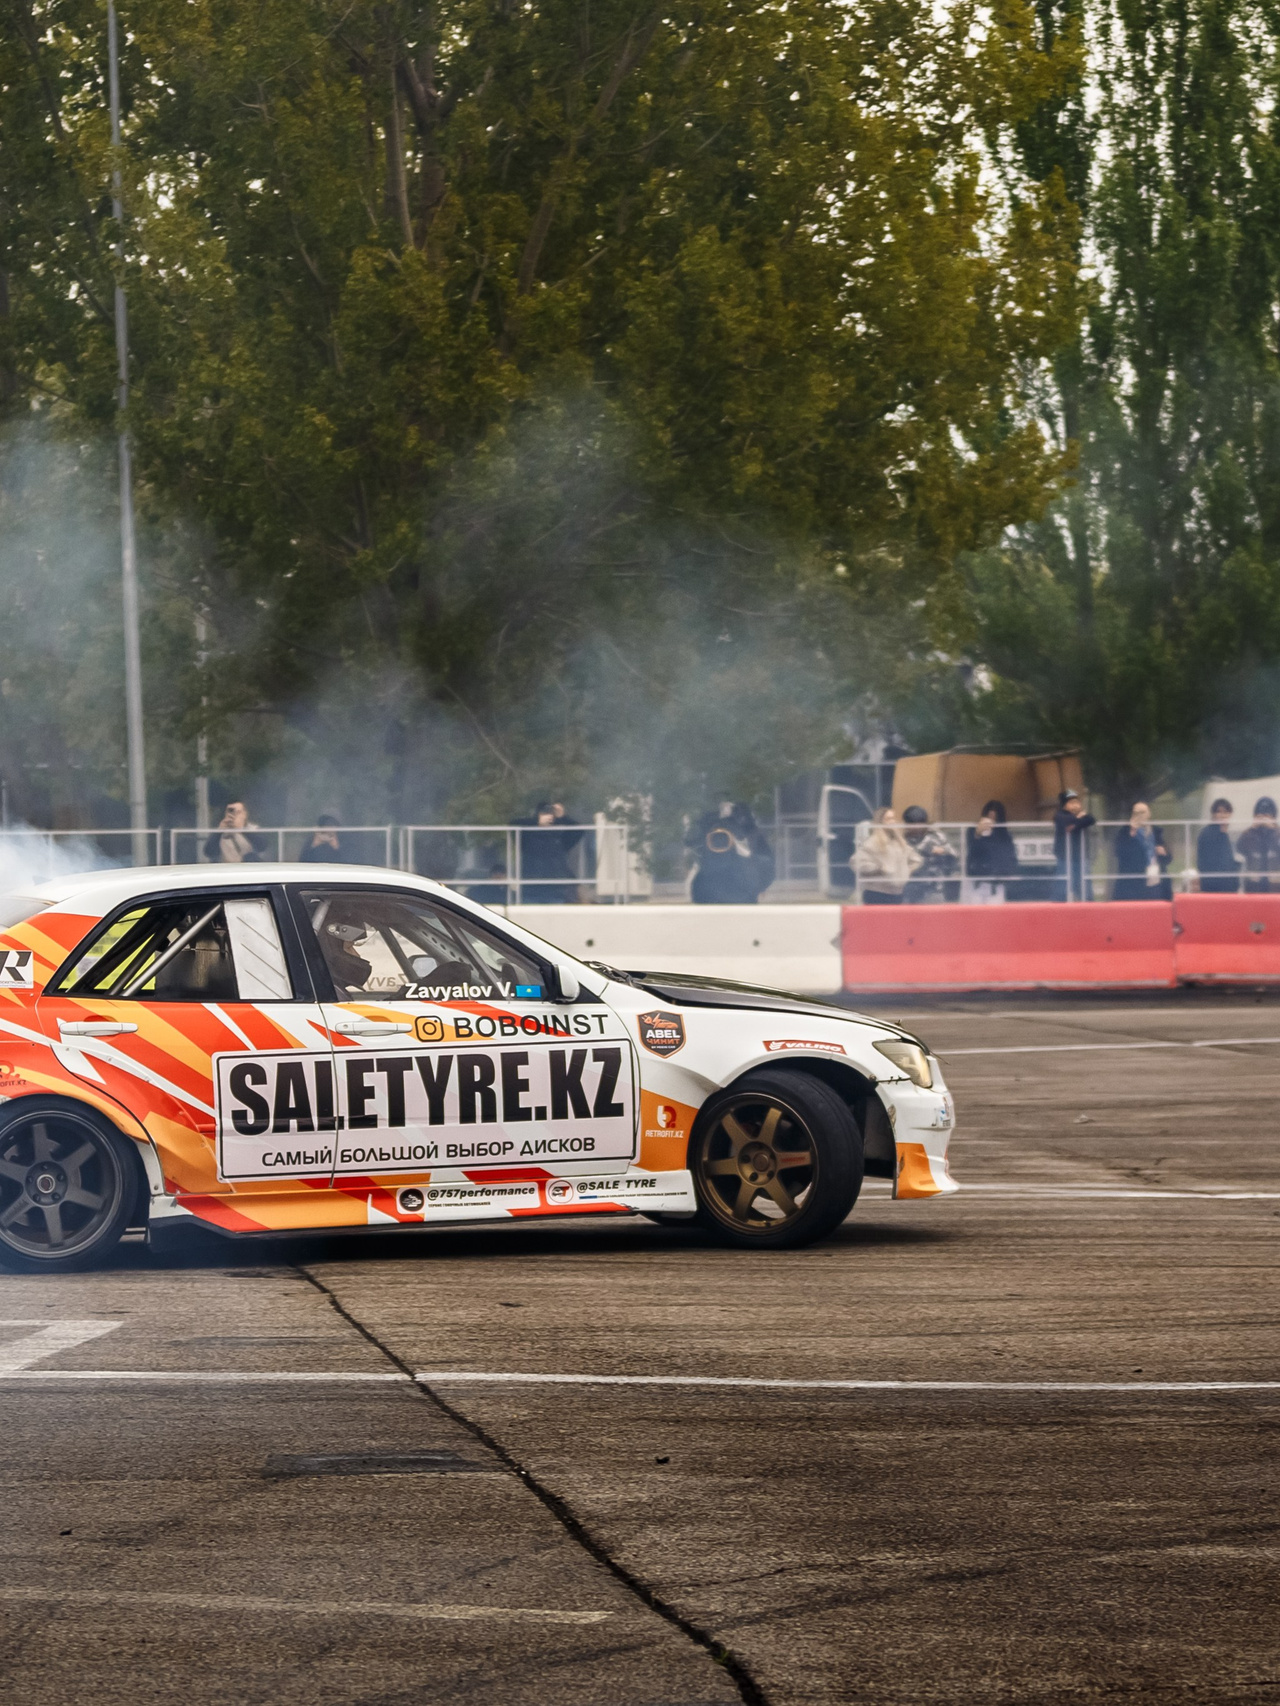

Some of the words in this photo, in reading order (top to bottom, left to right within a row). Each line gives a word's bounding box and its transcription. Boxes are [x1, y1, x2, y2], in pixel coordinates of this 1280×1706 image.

[405, 982, 493, 1001] Zavyalov
[496, 981, 515, 997] V.
[453, 1014, 609, 1038] BOBOINST
[645, 1029, 681, 1039] ABEL
[785, 1042, 841, 1052] VALINO
[229, 1046, 625, 1136] SALETYRE.KZ
[644, 1129, 684, 1138] RETROFIT.KZ
[261, 1146, 332, 1167] САМЫЙ
[339, 1140, 440, 1164] БОЛЬШОЙ
[446, 1140, 515, 1160] ВЫБОР
[519, 1136, 596, 1157] ДИСКОВ
[427, 1185, 536, 1202] @757performance
